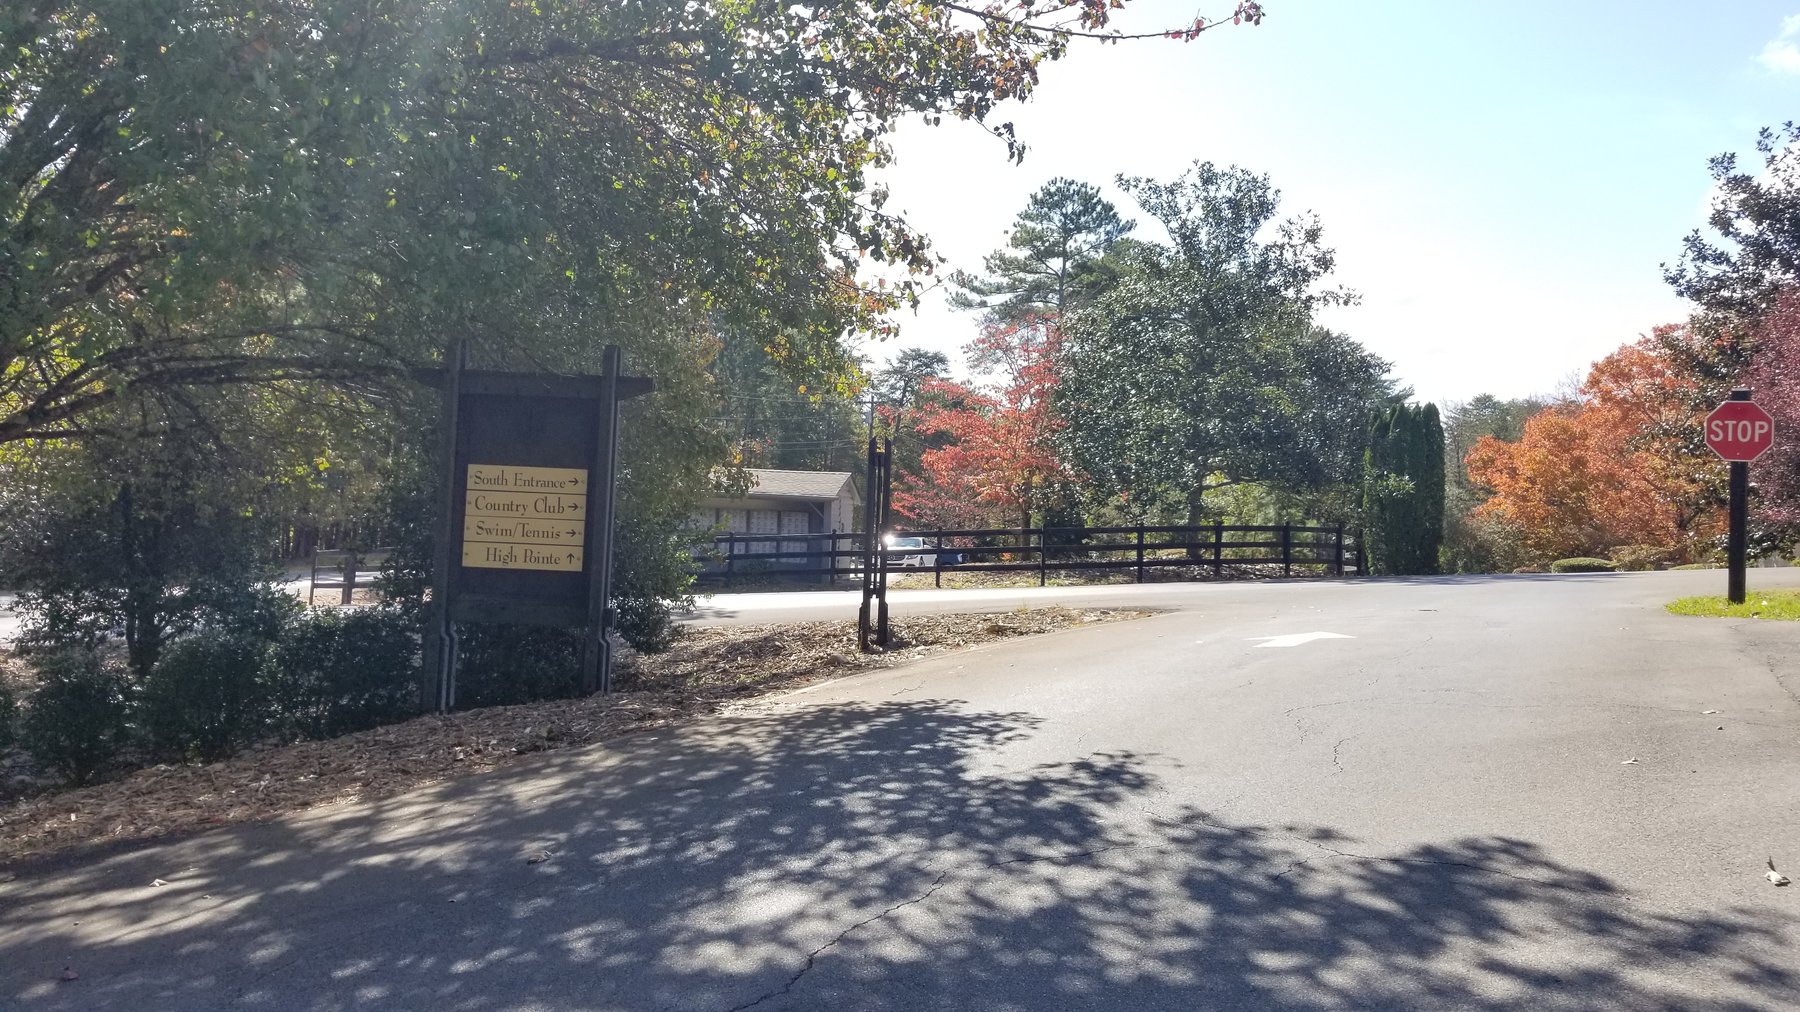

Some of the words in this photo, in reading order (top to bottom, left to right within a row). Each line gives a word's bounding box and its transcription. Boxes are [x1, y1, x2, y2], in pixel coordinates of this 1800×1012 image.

[1710, 420, 1769, 443] STOP
[474, 470, 508, 486] South
[513, 472, 566, 489] Entrance
[475, 495, 528, 516] Country
[534, 496, 565, 514] Club
[476, 520, 561, 539] Swim/Tennis
[485, 546, 517, 566] High
[523, 548, 561, 565] Pointe
